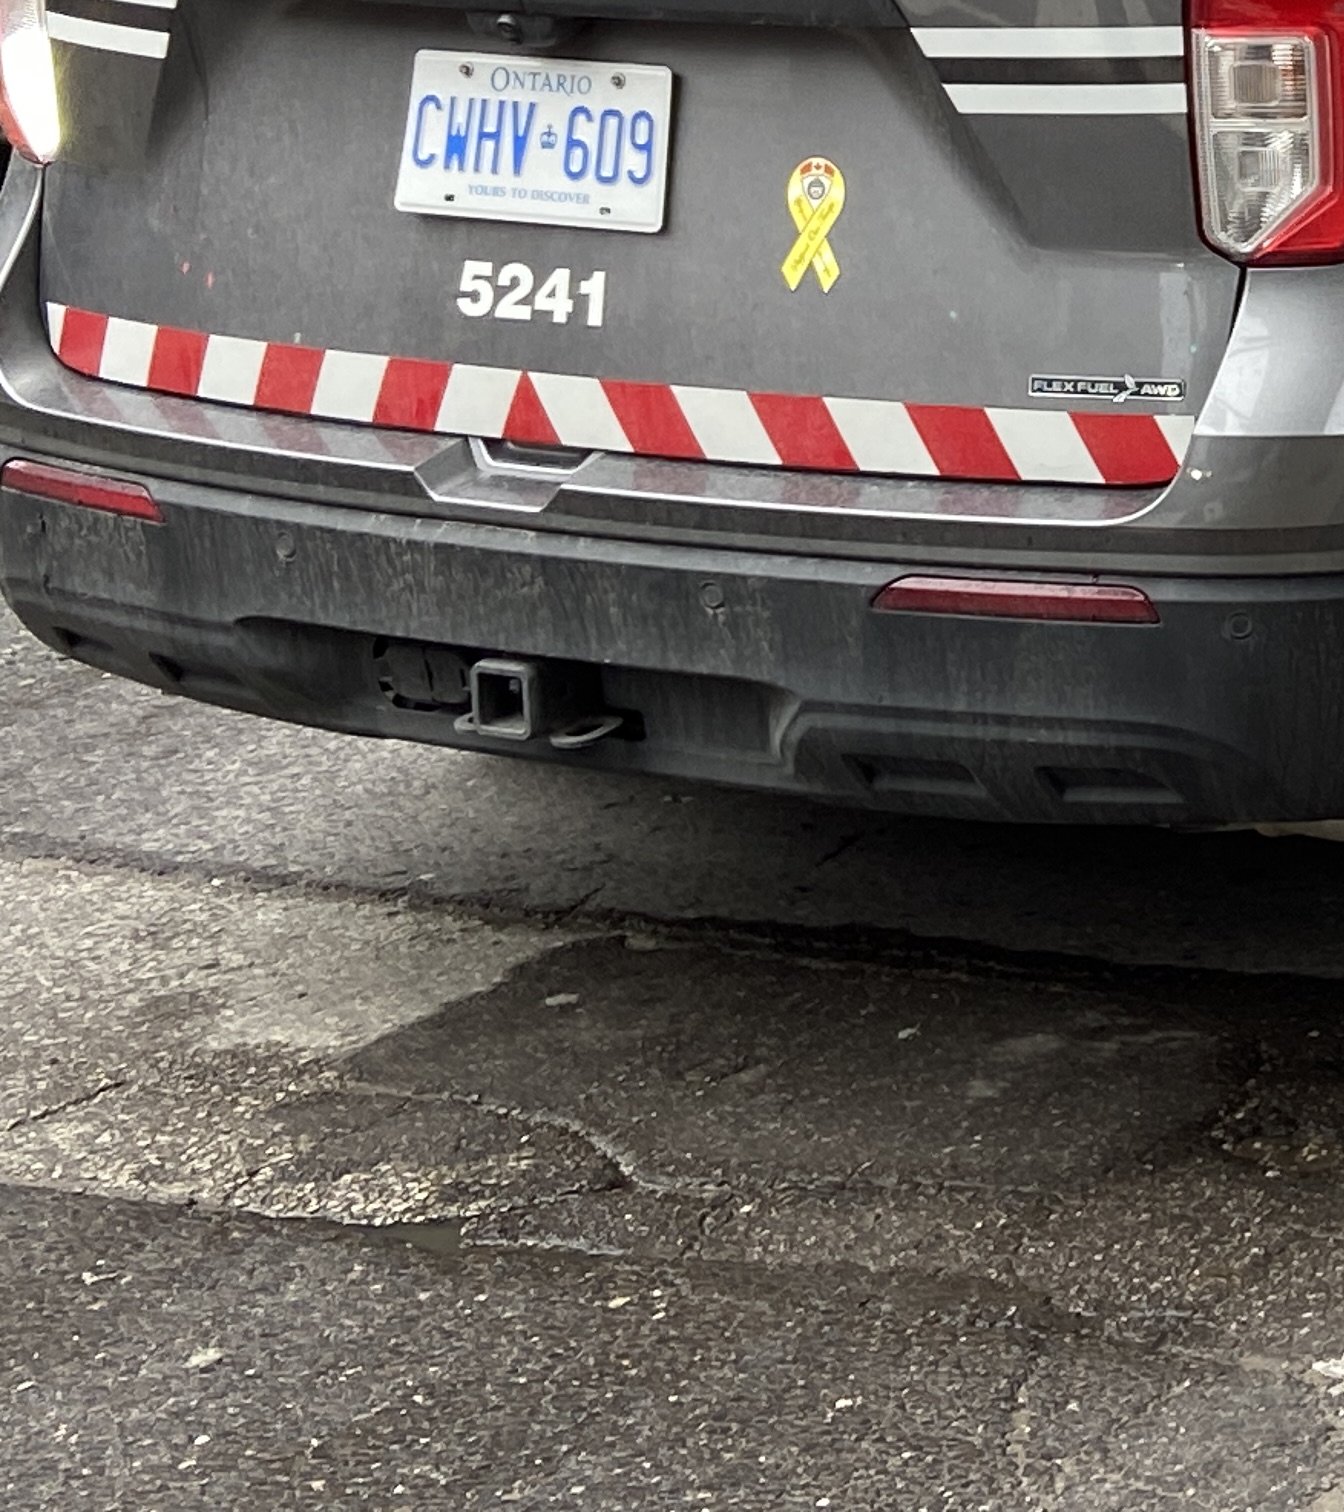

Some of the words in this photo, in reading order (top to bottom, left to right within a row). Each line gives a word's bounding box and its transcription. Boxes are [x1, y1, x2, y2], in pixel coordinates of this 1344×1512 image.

[491, 66, 592, 96] ONTARIO
[412, 94, 538, 177] CWHV
[563, 106, 655, 185] 609
[468, 184, 507, 197] YOURS
[512, 187, 528, 199] TO
[531, 189, 590, 205] DISCOVER
[456, 259, 607, 327] 5241
[1033, 379, 1075, 393] FLEX
[1077, 381, 1119, 394] FUEL
[1140, 383, 1180, 397] AWD
